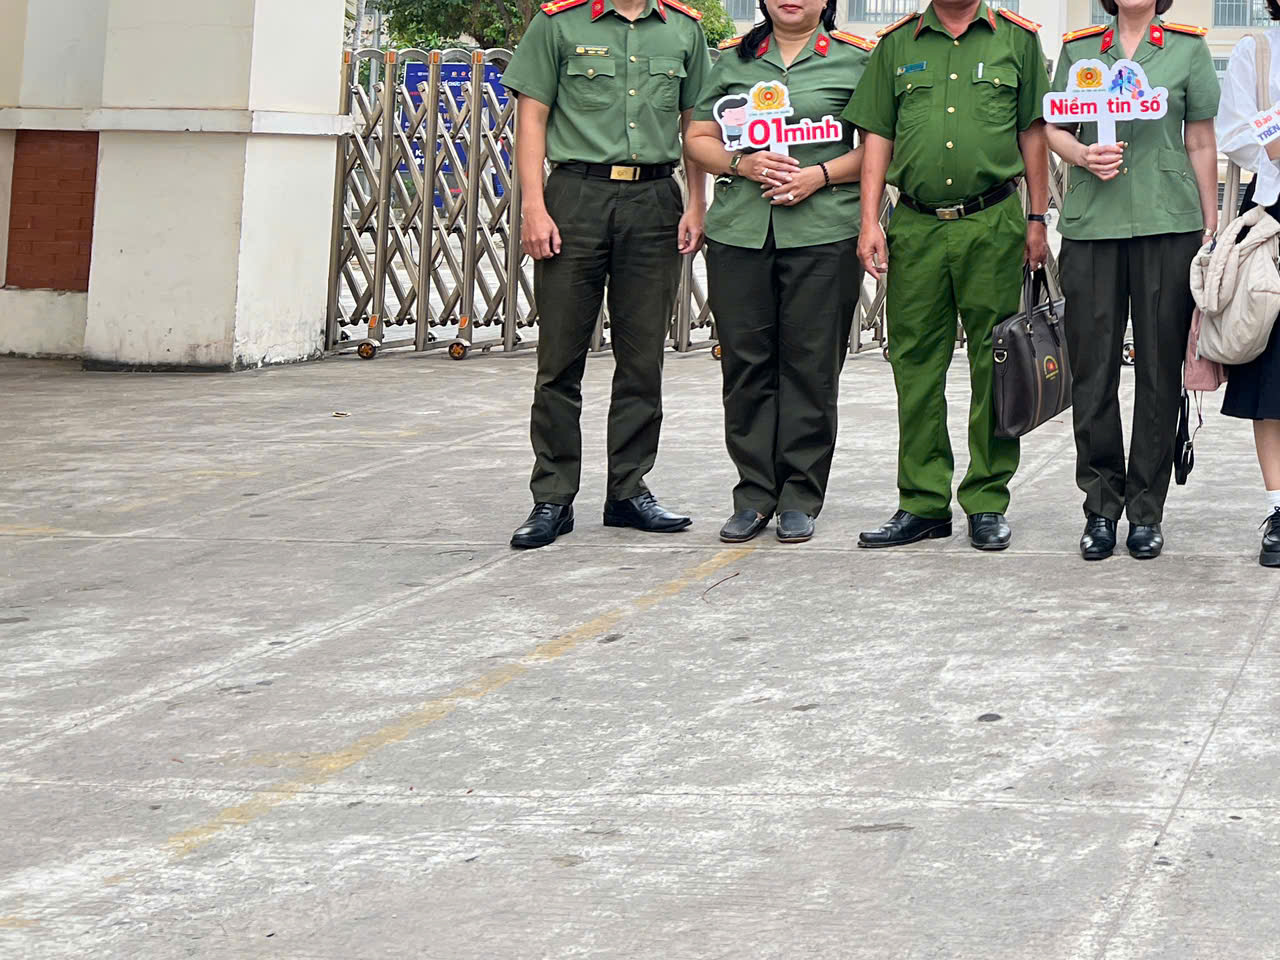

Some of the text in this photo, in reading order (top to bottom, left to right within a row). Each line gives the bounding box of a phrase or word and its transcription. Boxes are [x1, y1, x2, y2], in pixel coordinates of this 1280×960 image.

[1050, 93, 1161, 116] Niềm tin số
